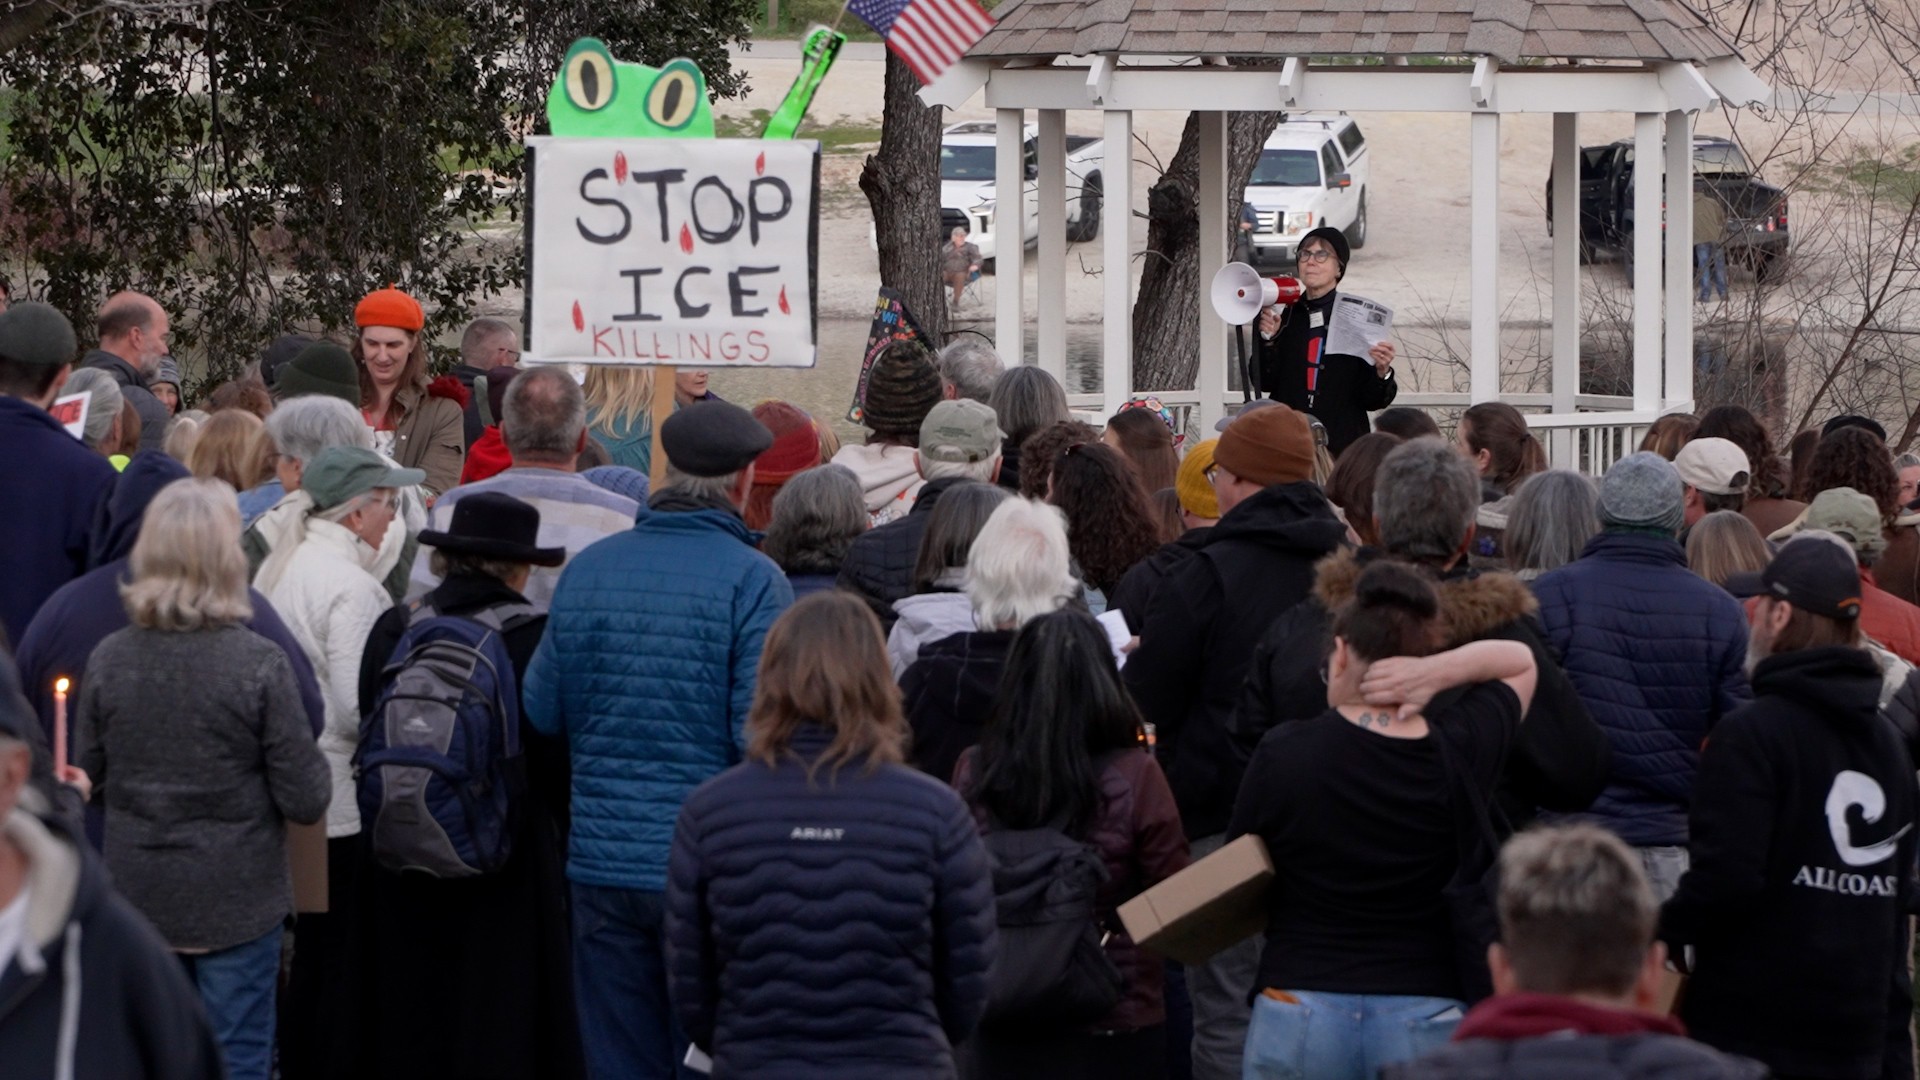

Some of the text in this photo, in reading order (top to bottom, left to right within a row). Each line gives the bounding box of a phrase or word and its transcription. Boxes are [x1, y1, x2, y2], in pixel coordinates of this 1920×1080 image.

[576, 168, 792, 247] STOP
[612, 265, 781, 322] ICE
[591, 324, 770, 363] KILLINGS
[864, 336, 892, 369] KINDNESS
[790, 827, 845, 840] ARIAT
